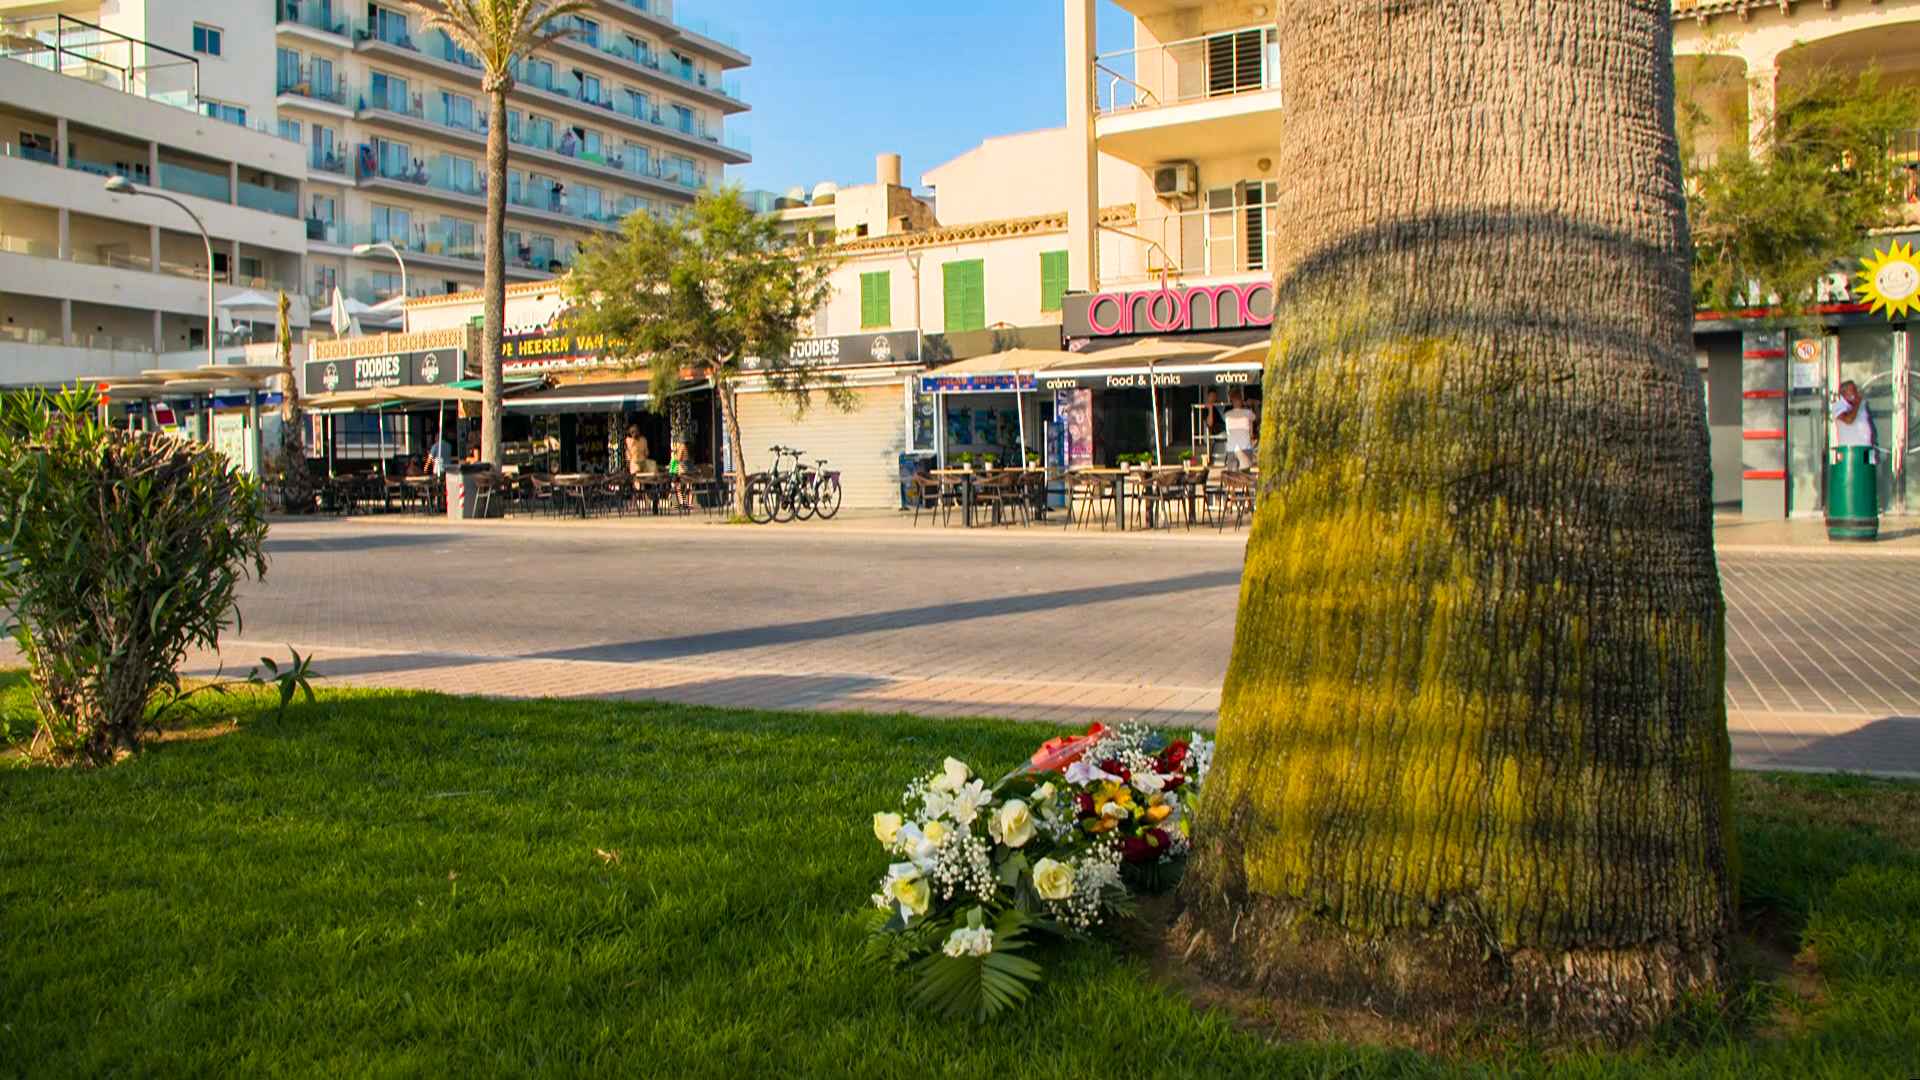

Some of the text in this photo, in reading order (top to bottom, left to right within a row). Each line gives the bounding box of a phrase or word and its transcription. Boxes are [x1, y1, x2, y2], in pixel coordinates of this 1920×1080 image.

[518, 337, 569, 356] HEEREN
[575, 333, 604, 350] VAN
[789, 338, 840, 358] FOODIES
[354, 355, 400, 378] FOODIES
[1106, 373, 1181, 387] Food & Drinks
